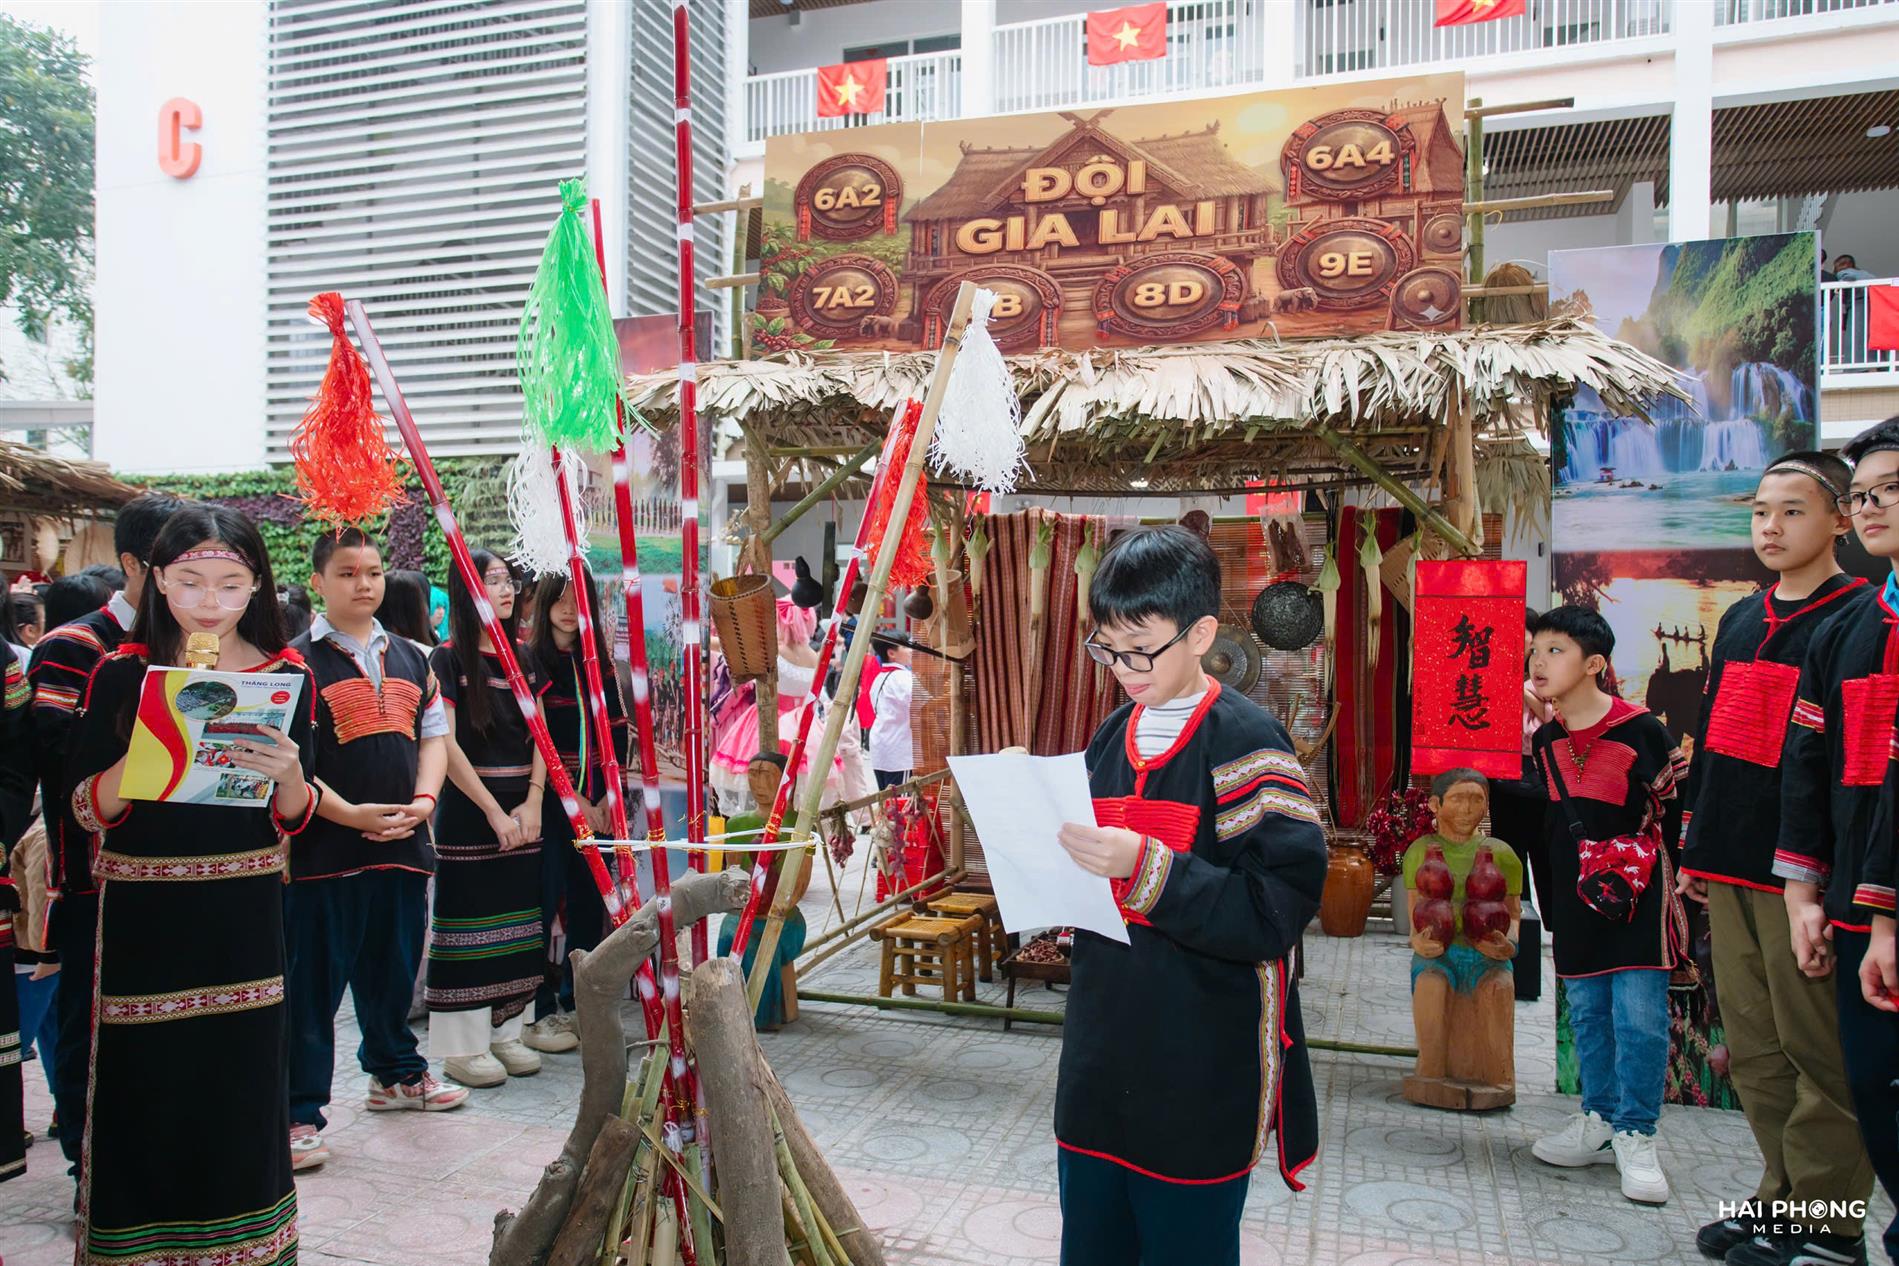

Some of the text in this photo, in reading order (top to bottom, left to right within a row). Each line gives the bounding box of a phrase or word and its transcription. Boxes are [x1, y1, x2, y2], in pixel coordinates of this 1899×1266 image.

[158, 96, 203, 180] C
[1306, 140, 1396, 171] 6A4
[1021, 155, 1146, 206] ĐỘI
[814, 184, 881, 212] 6A2
[956, 200, 1216, 255] GIA LAI
[1319, 251, 1373, 278] 9E
[812, 285, 875, 309] 7A2
[1134, 281, 1204, 307] 8D
[1447, 614, 1495, 731] 智慧
